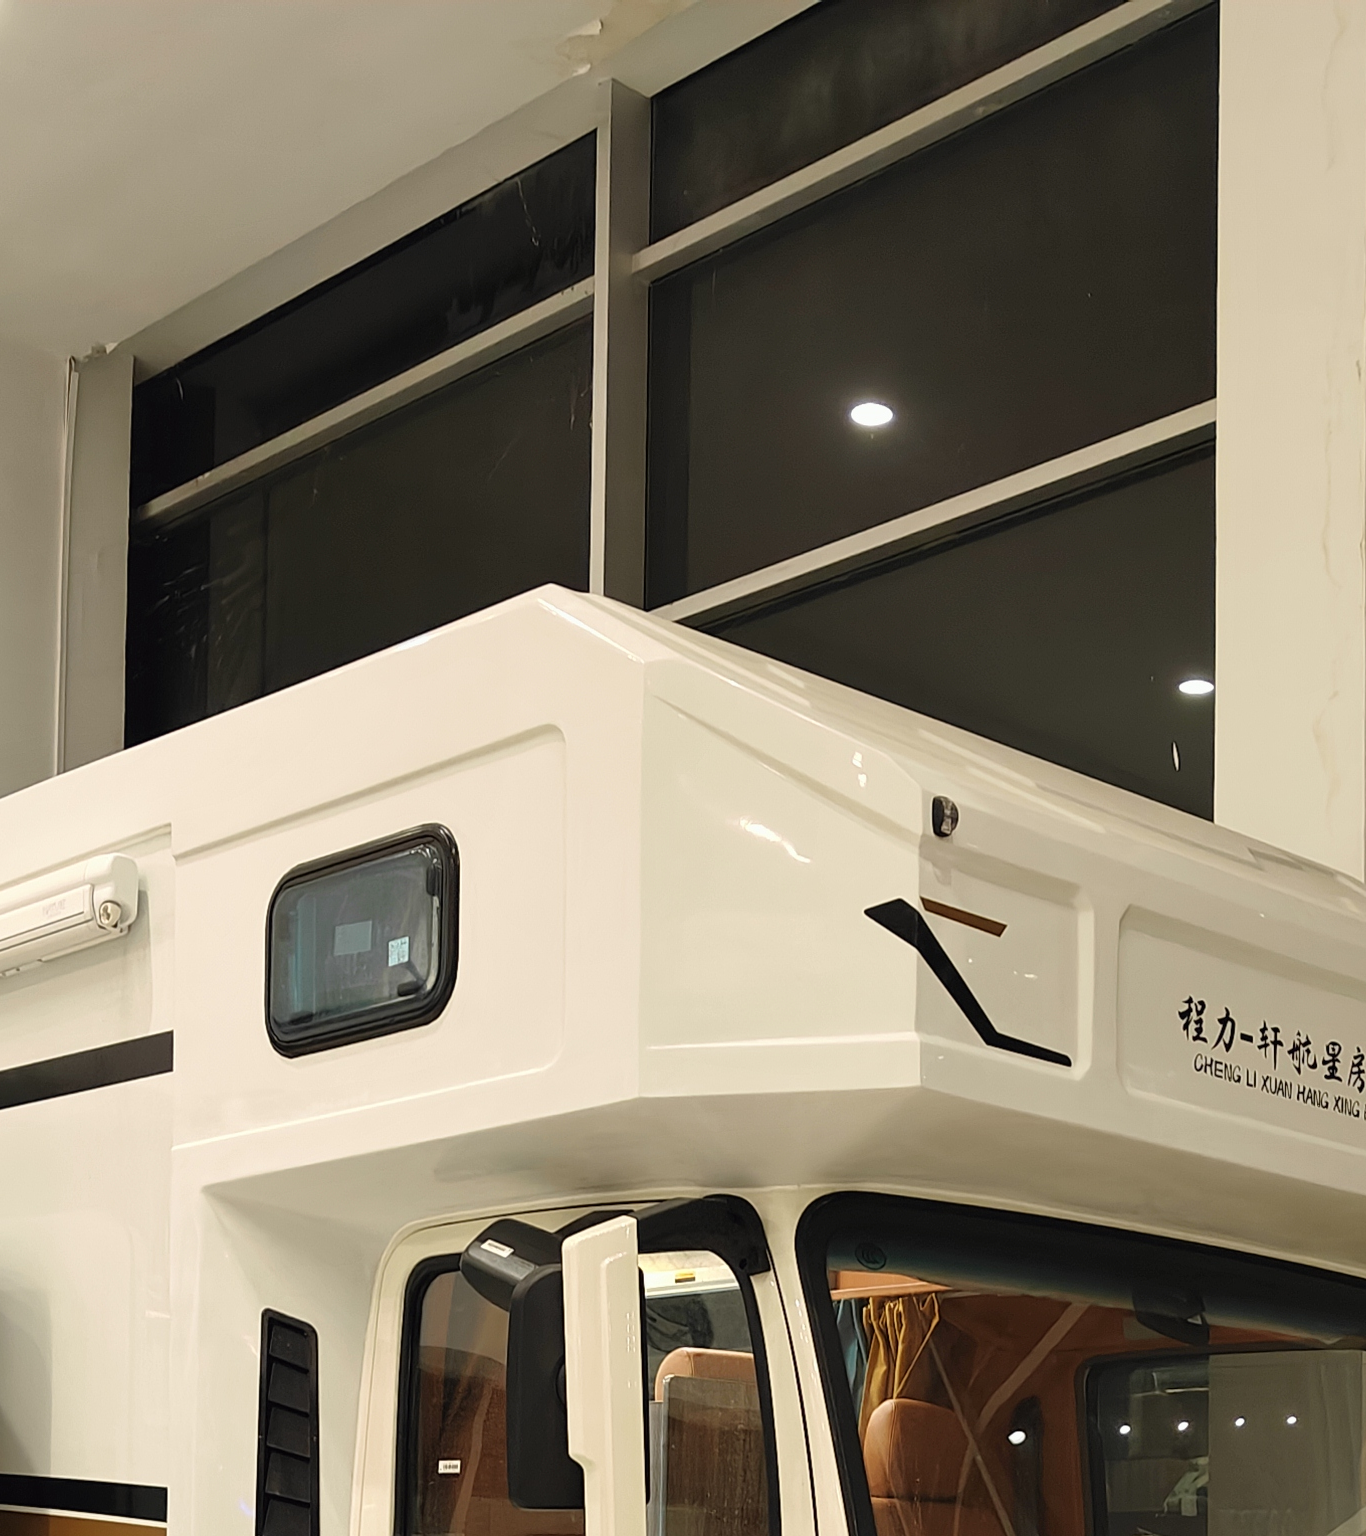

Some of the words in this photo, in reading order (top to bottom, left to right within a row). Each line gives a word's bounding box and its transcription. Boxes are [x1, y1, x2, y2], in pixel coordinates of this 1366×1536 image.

[1193, 1053, 1242, 1084] CHENG
[1245, 1068, 1257, 1089] LI
[1261, 1074, 1294, 1100] XUAN
[1296, 1083, 1330, 1111] HANG
[1332, 1095, 1361, 1119] XING
